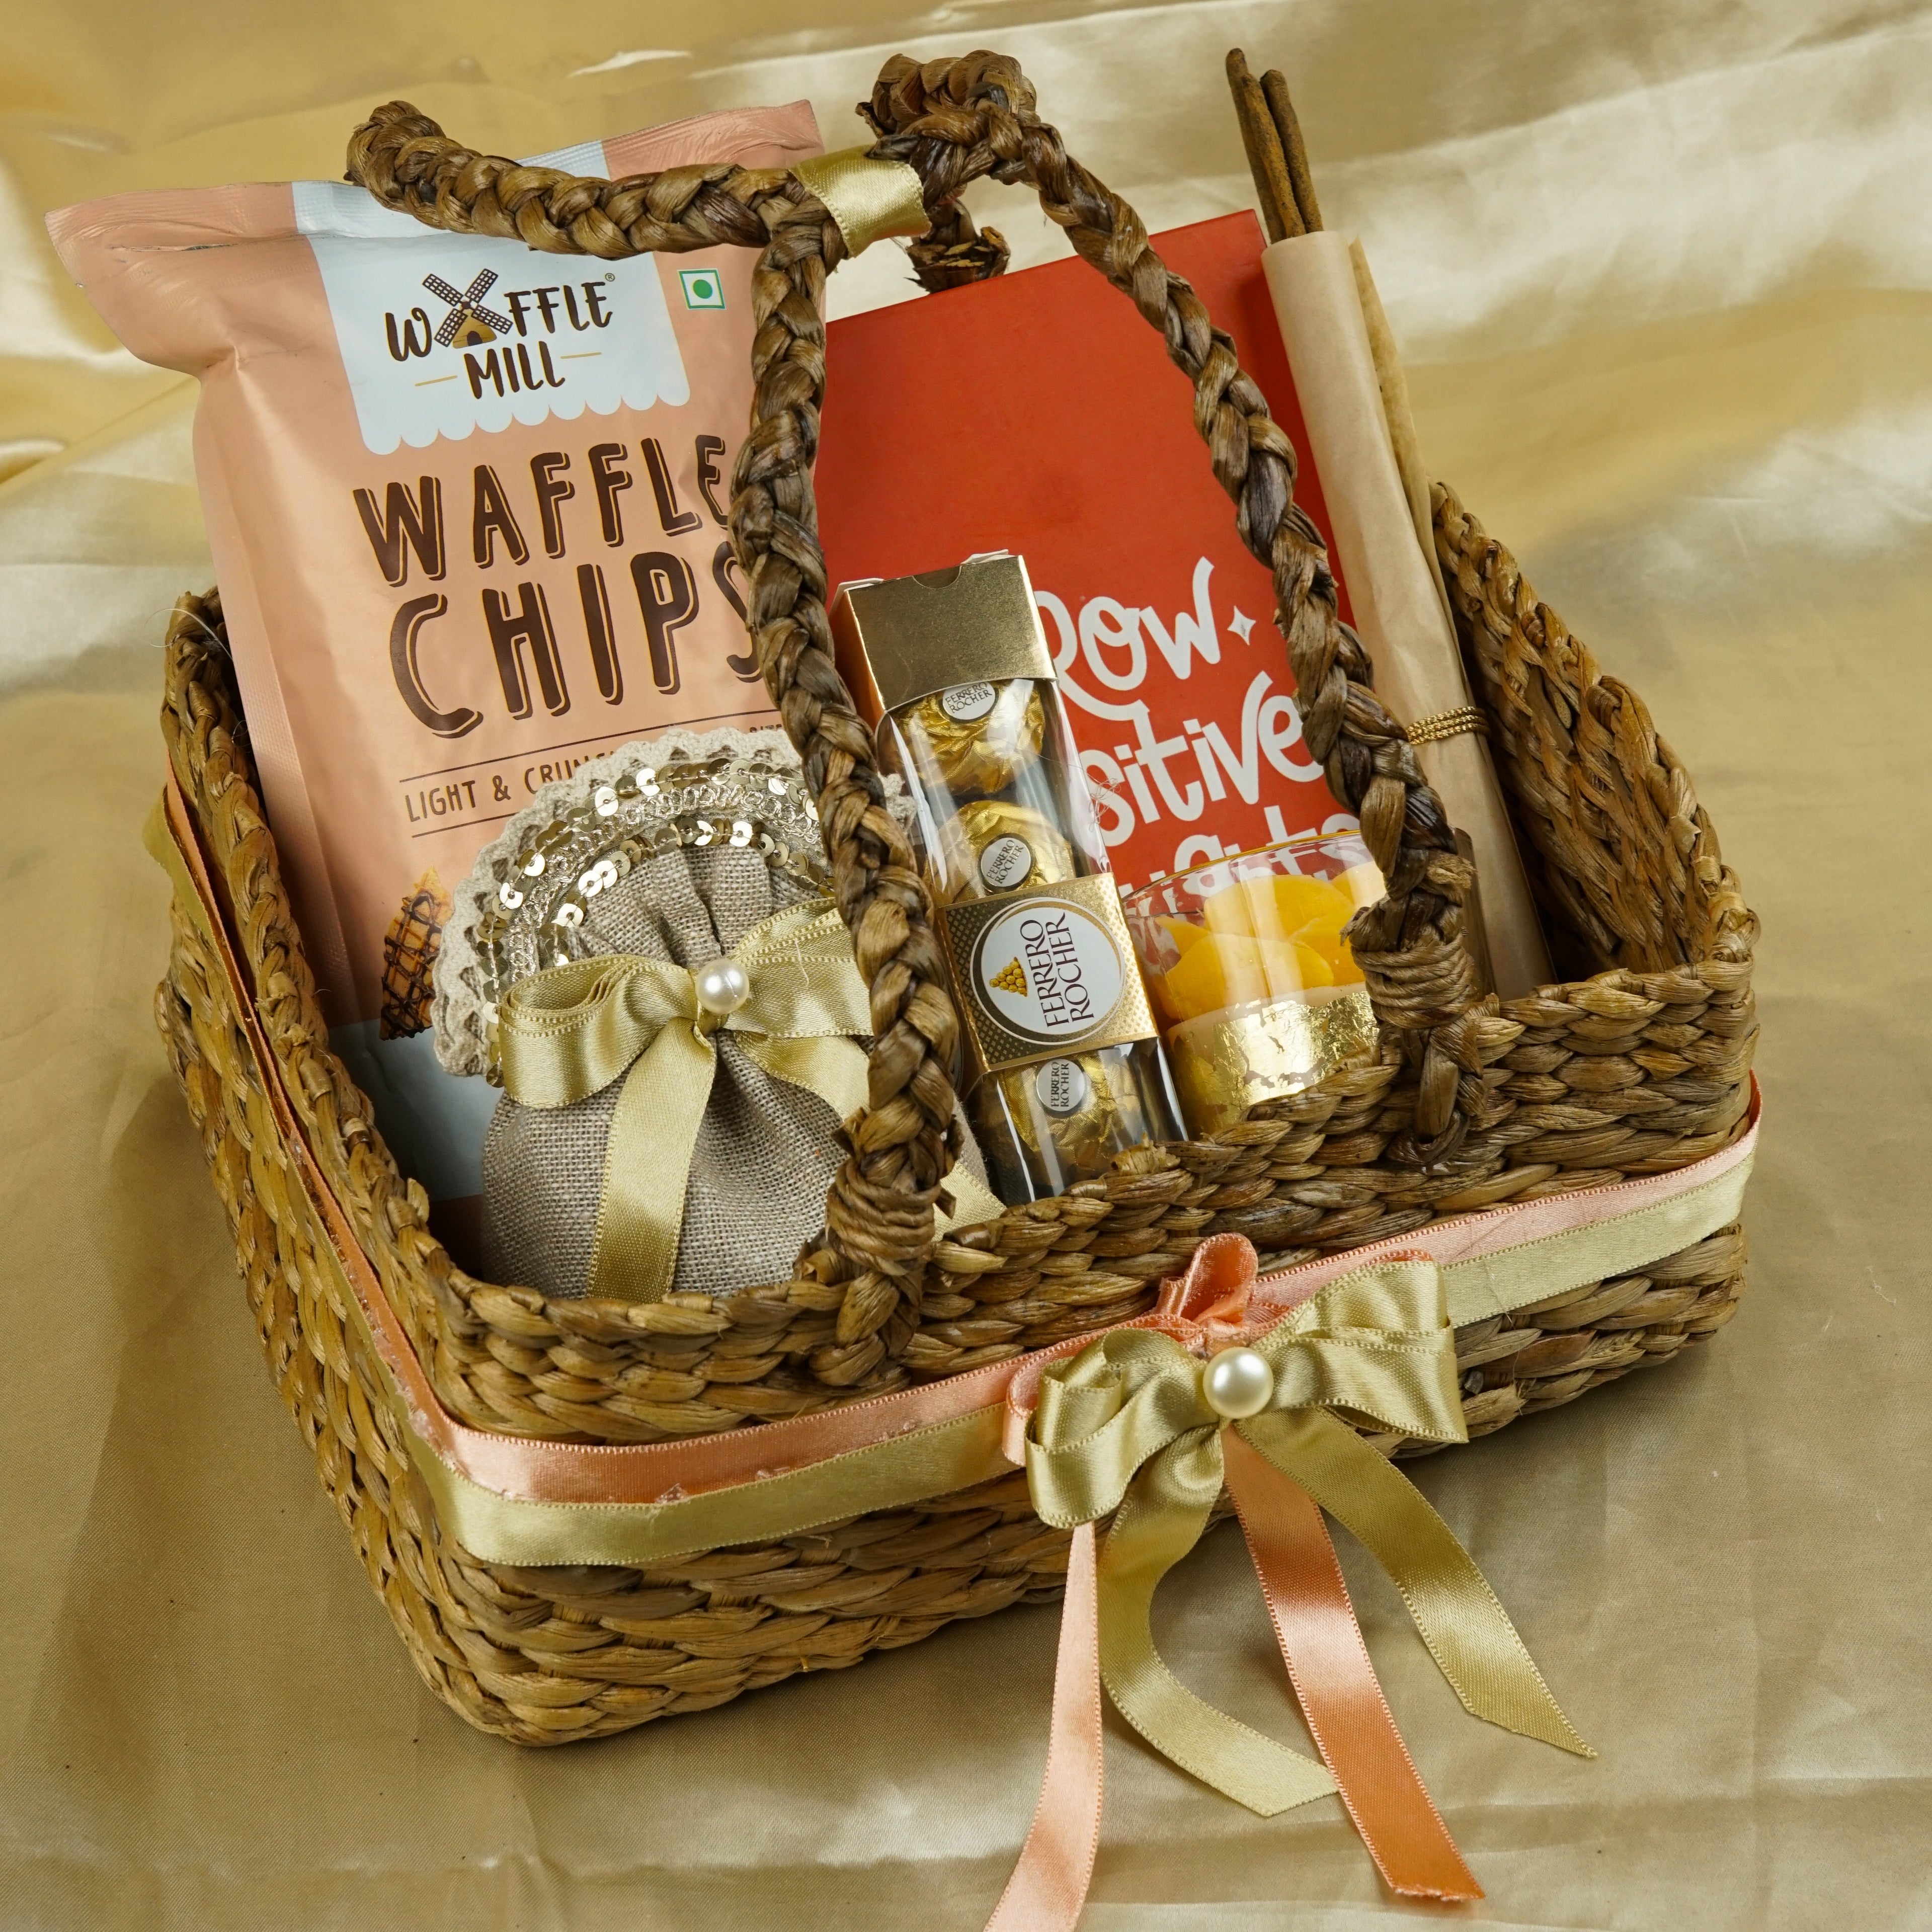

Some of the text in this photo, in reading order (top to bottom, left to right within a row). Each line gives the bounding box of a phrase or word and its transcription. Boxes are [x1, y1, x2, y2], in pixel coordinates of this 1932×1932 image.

[464, 340, 565, 399] MILL
[353, 435, 730, 587] WAFFLE
[390, 540, 763, 739] CHIPS
[945, 682, 987, 705] FERRERO
[949, 689, 992, 713] ROCHER
[406, 780, 476, 822] LIGHT
[492, 775, 511, 801] &
[987, 840, 1015, 879] FERRERO
[995, 845, 1024, 884] ROCHER
[1020, 920, 1070, 1027] FERRERO
[1045, 912, 1094, 1022] ROCHER
[1051, 1062, 1060, 1107] FERRERO
[1060, 1063, 1069, 1107] ROCHER
